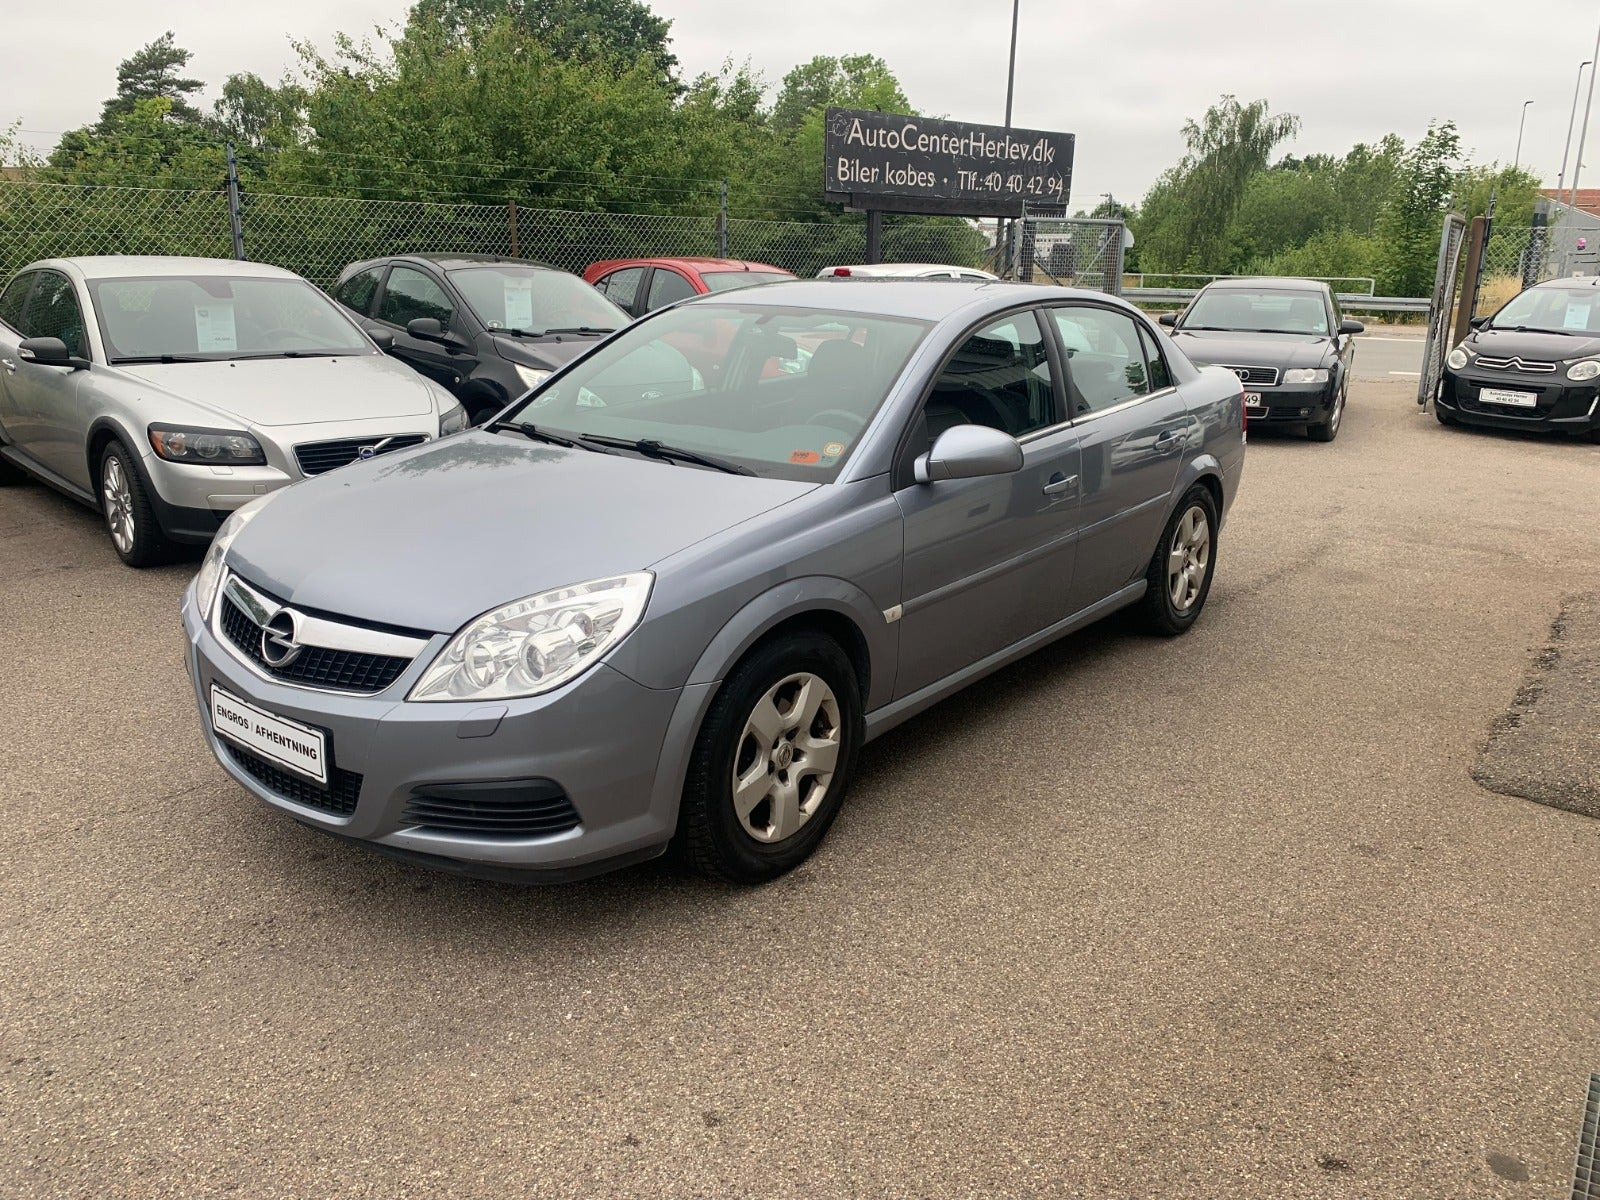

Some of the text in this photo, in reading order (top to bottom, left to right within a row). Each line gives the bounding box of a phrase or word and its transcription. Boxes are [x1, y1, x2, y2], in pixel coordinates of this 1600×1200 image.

[847, 118, 1055, 164] AutoCenterHerlev.dk
[837, 157, 879, 183] Biler
[885, 162, 936, 187] købes
[1006, 174, 1023, 193] 40
[1026, 176, 1043, 194] 42
[1047, 177, 1063, 196] 94
[216, 704, 318, 760] ENGROS AFHENTNING
